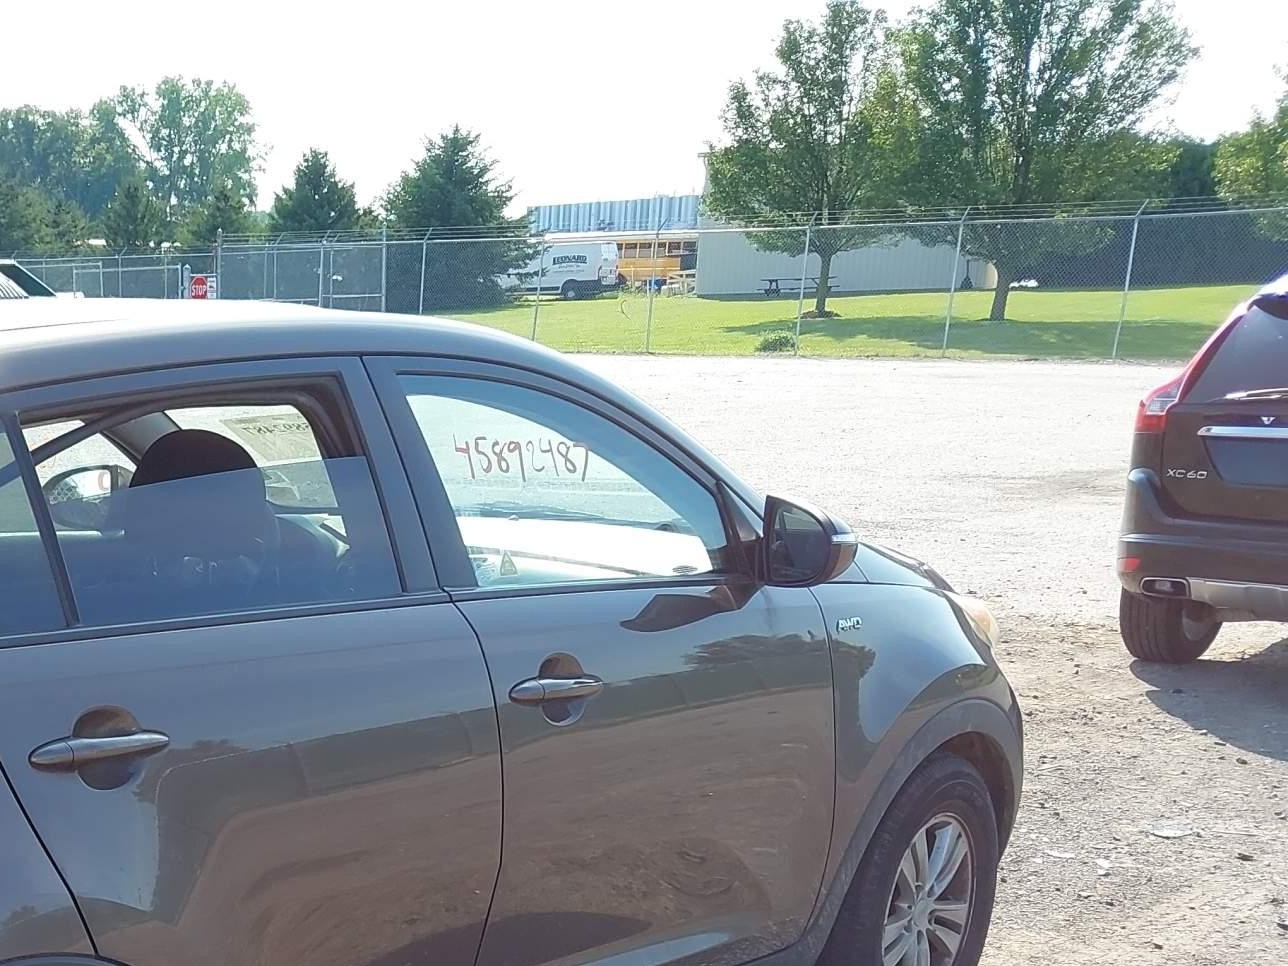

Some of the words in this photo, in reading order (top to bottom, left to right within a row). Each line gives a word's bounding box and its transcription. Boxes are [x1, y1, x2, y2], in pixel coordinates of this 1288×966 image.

[192, 284, 207, 297] STOP
[453, 434, 589, 482] 45892487
[837, 616, 863, 631] AWD
